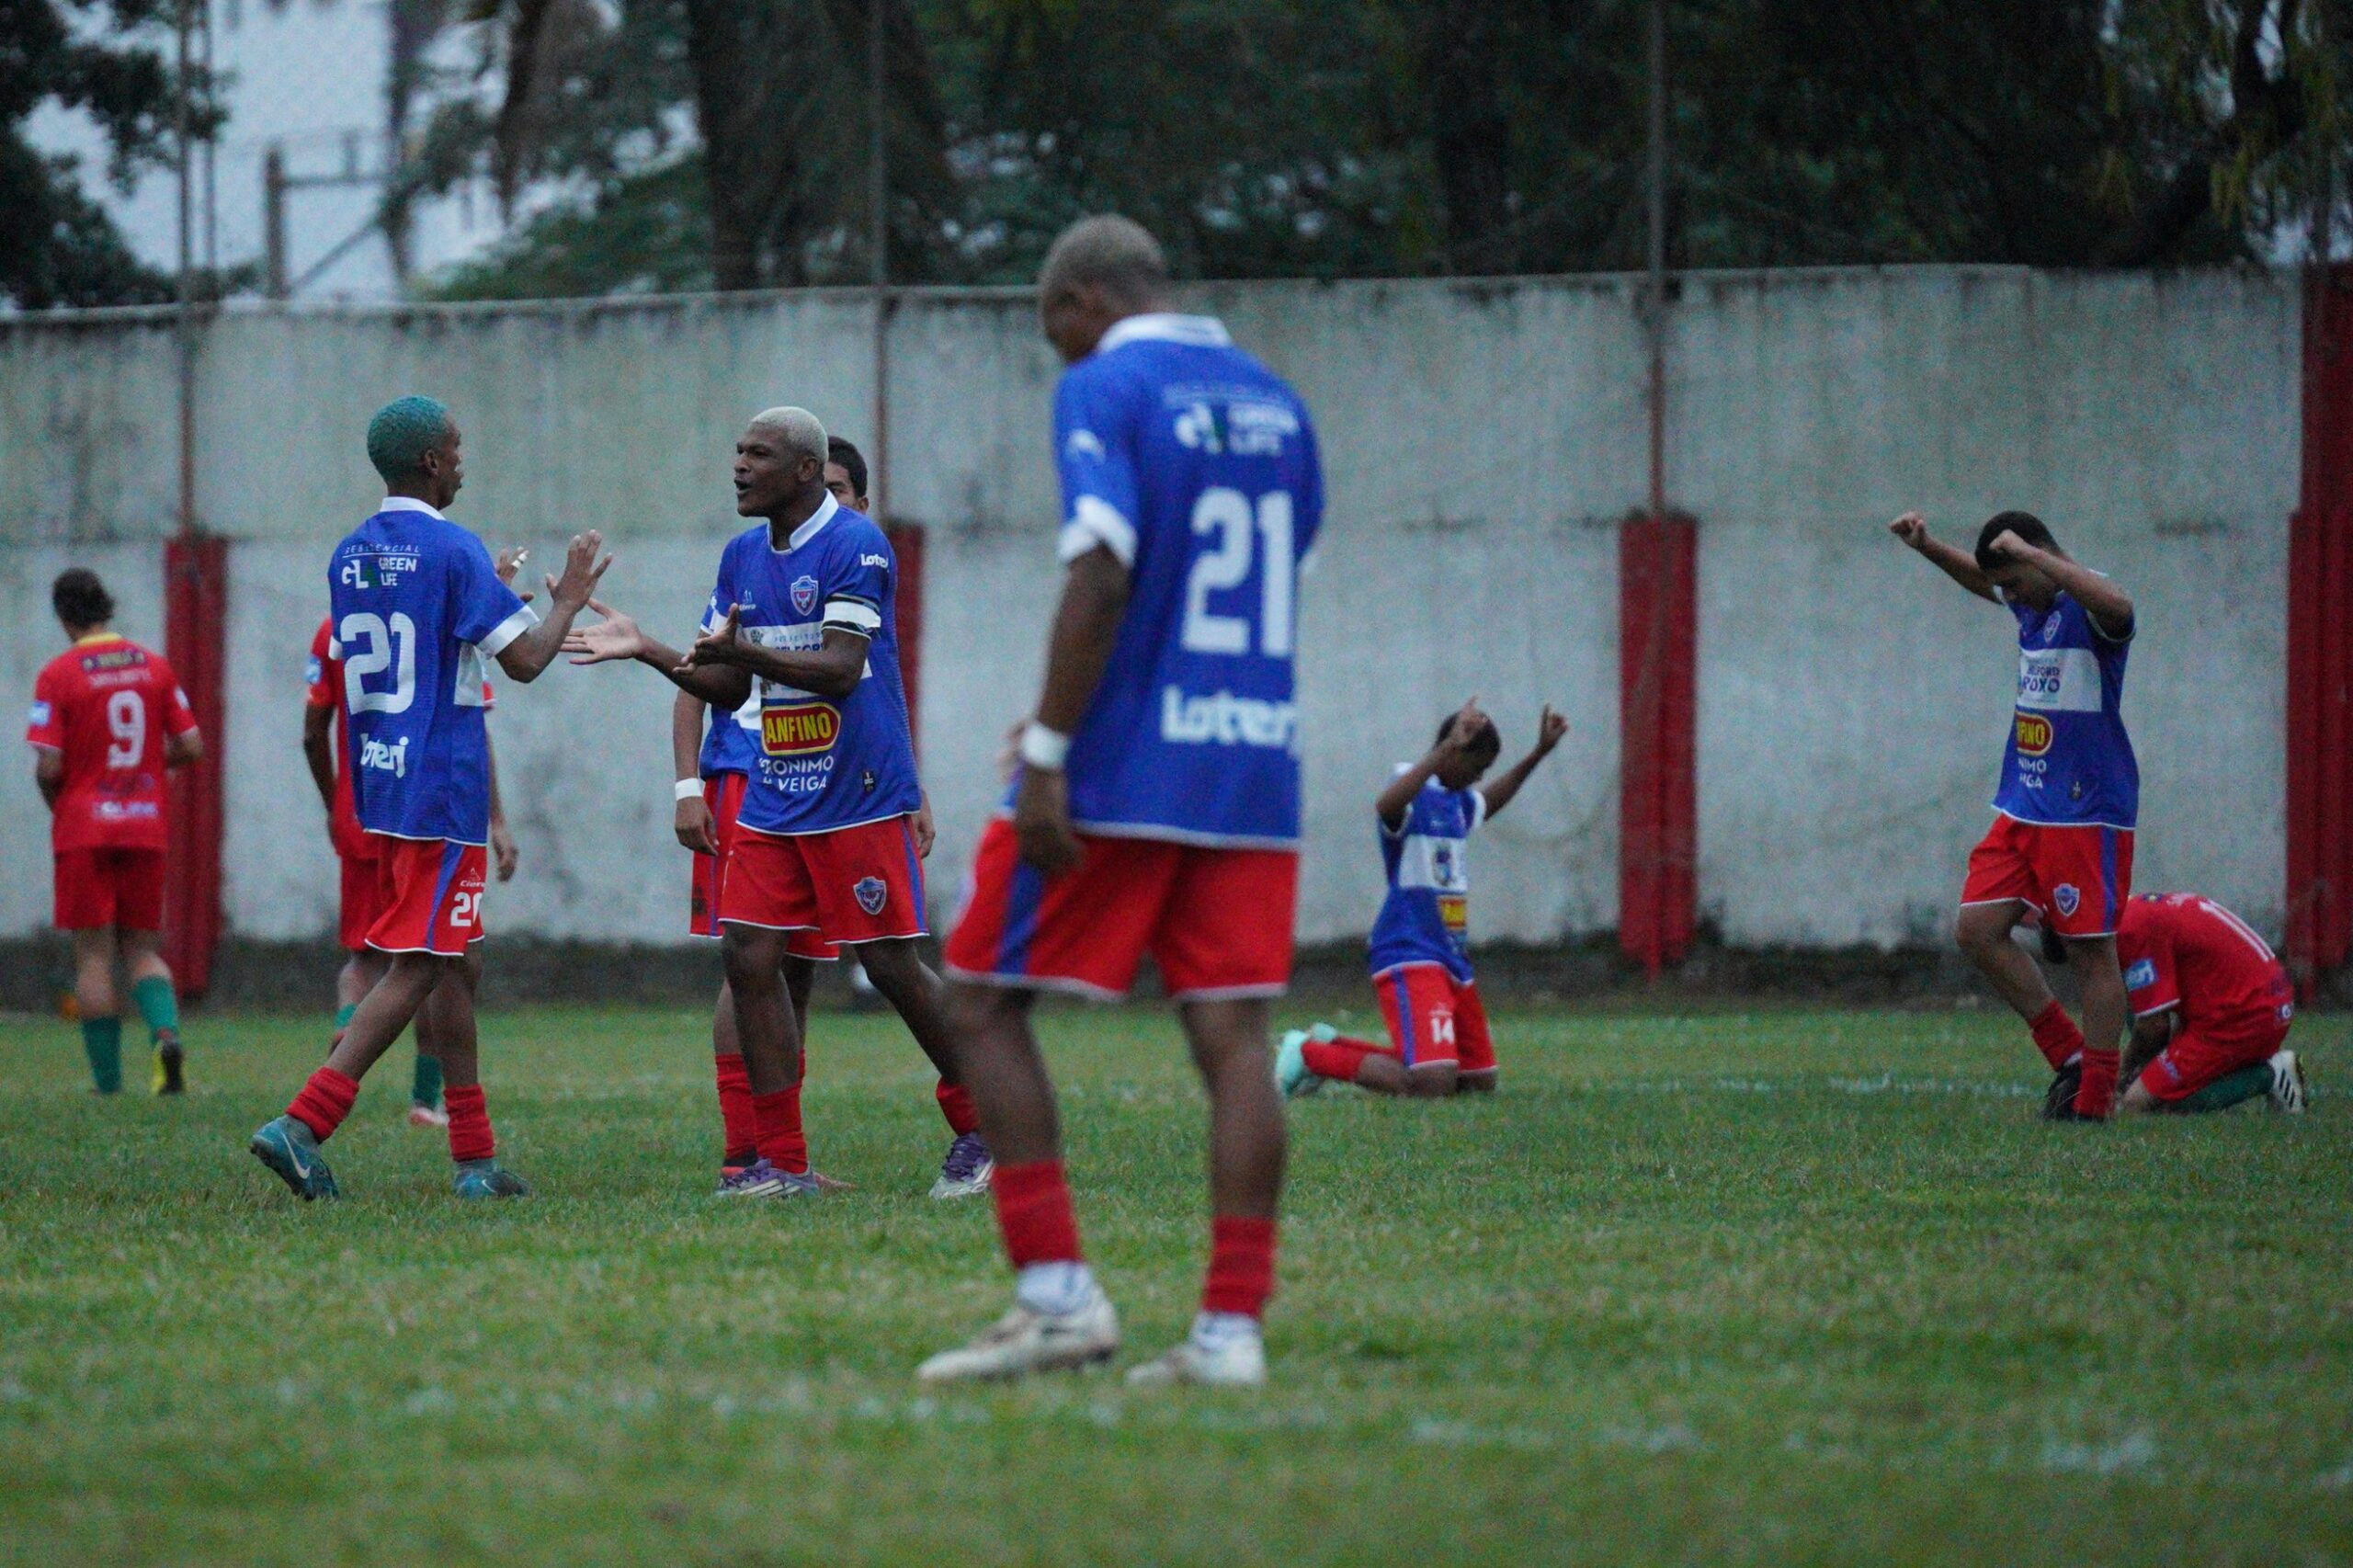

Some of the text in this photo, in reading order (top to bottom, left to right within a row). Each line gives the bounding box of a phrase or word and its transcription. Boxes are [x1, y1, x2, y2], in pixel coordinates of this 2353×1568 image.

[1181, 485, 1294, 657] 21
[107, 689, 145, 769] 9
[778, 776, 827, 792] VEIGA
[1431, 1017, 1456, 1044] 14
